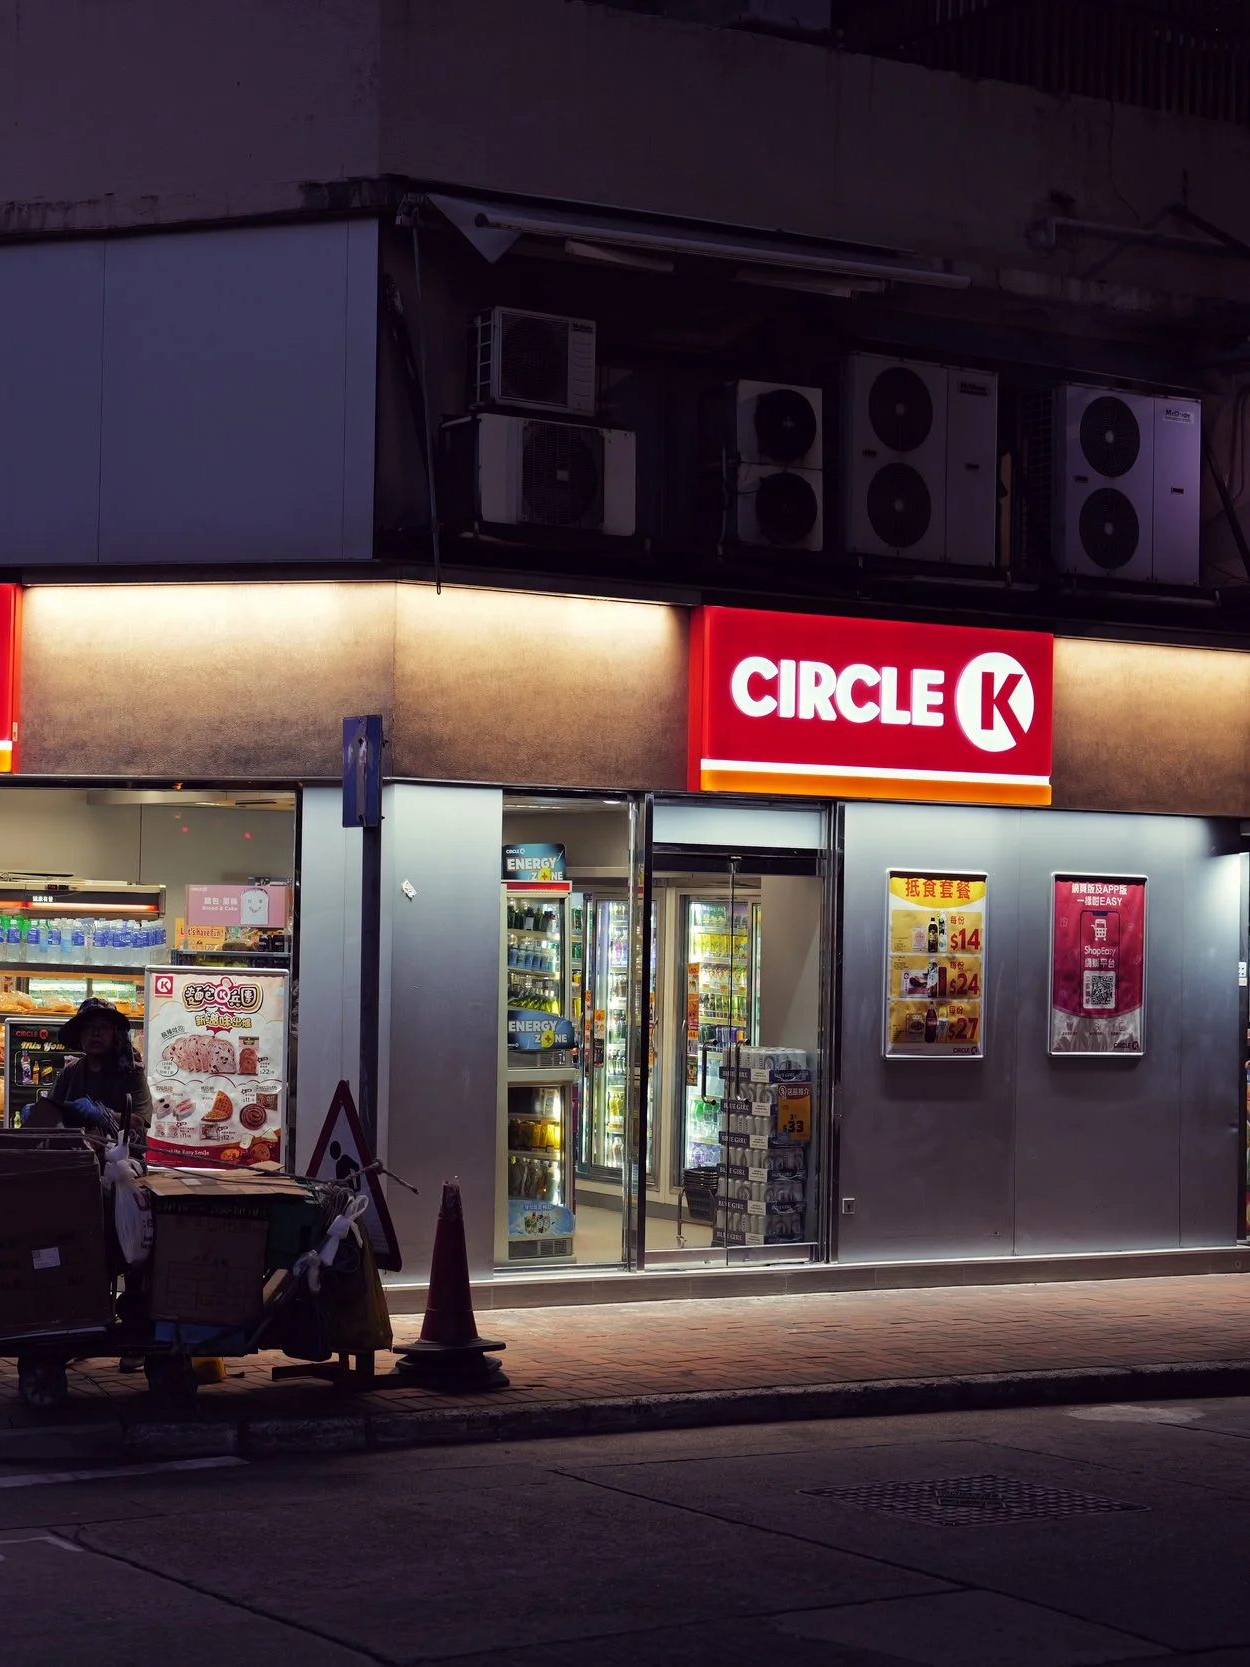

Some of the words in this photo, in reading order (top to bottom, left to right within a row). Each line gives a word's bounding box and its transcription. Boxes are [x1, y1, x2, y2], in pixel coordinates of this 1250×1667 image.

[731, 656, 944, 727] CIRCLE
[974, 663, 1031, 746] K
[507, 858, 556, 870] ENERGY
[905, 879, 970, 899] 抵食套餐
[950, 916, 964, 925] 每份
[196, 928, 210, 936] have
[950, 928, 980, 950] $14
[1084, 945, 1116, 956] ShopEasy
[950, 961, 964, 970] 每份
[158, 979, 171, 992] K
[950, 973, 979, 995] $24
[949, 1006, 963, 1015] 每份
[508, 1021, 558, 1031] ENERGY
[948, 1018, 978, 1040] $27
[21, 1042, 41, 1050] Mix
[733, 1168, 746, 1176] GIRL
